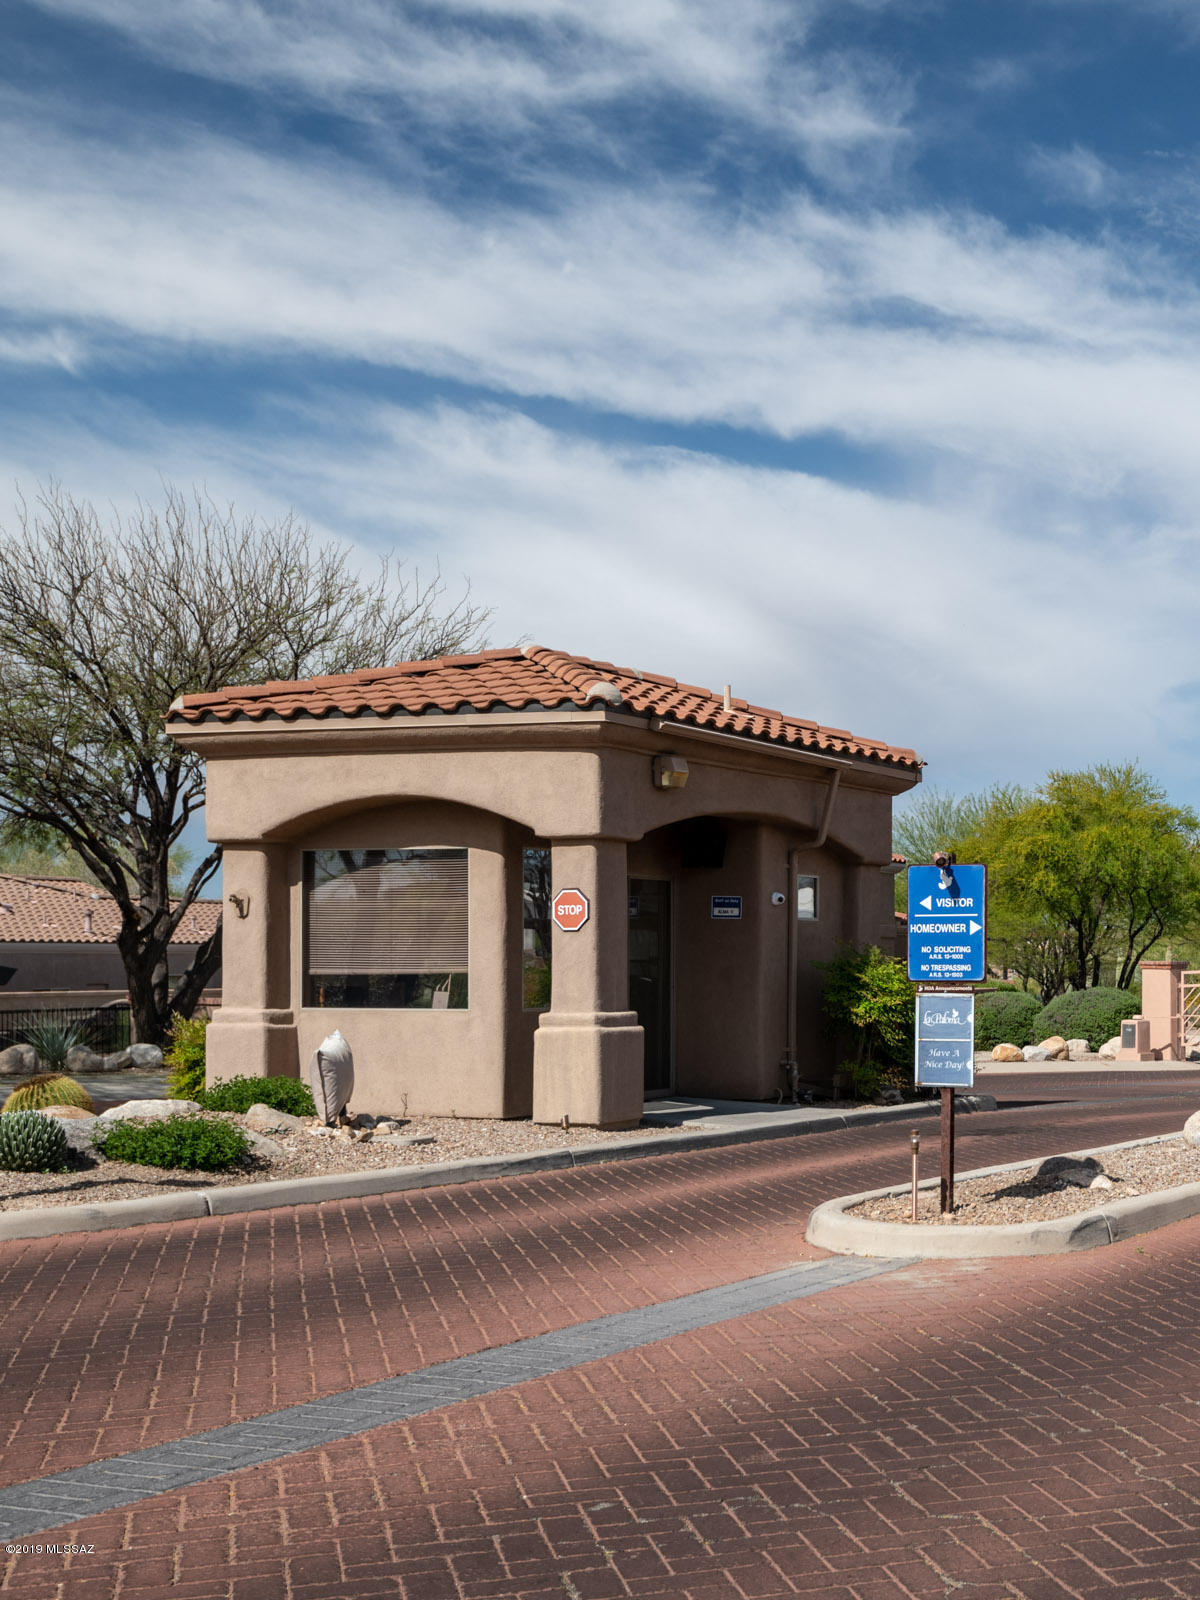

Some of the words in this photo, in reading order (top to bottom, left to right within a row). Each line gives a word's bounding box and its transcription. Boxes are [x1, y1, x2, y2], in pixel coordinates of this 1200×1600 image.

[936, 898, 973, 907] VISITOR
[557, 904, 583, 916] STOP
[910, 924, 966, 933] HOMEOWNER
[932, 1010, 967, 1026] Paloma
[928, 1048, 951, 1057] Have
[952, 1049, 960, 1057] A
[924, 1060, 944, 1068] Nice
[944, 1060, 965, 1072] Day!
